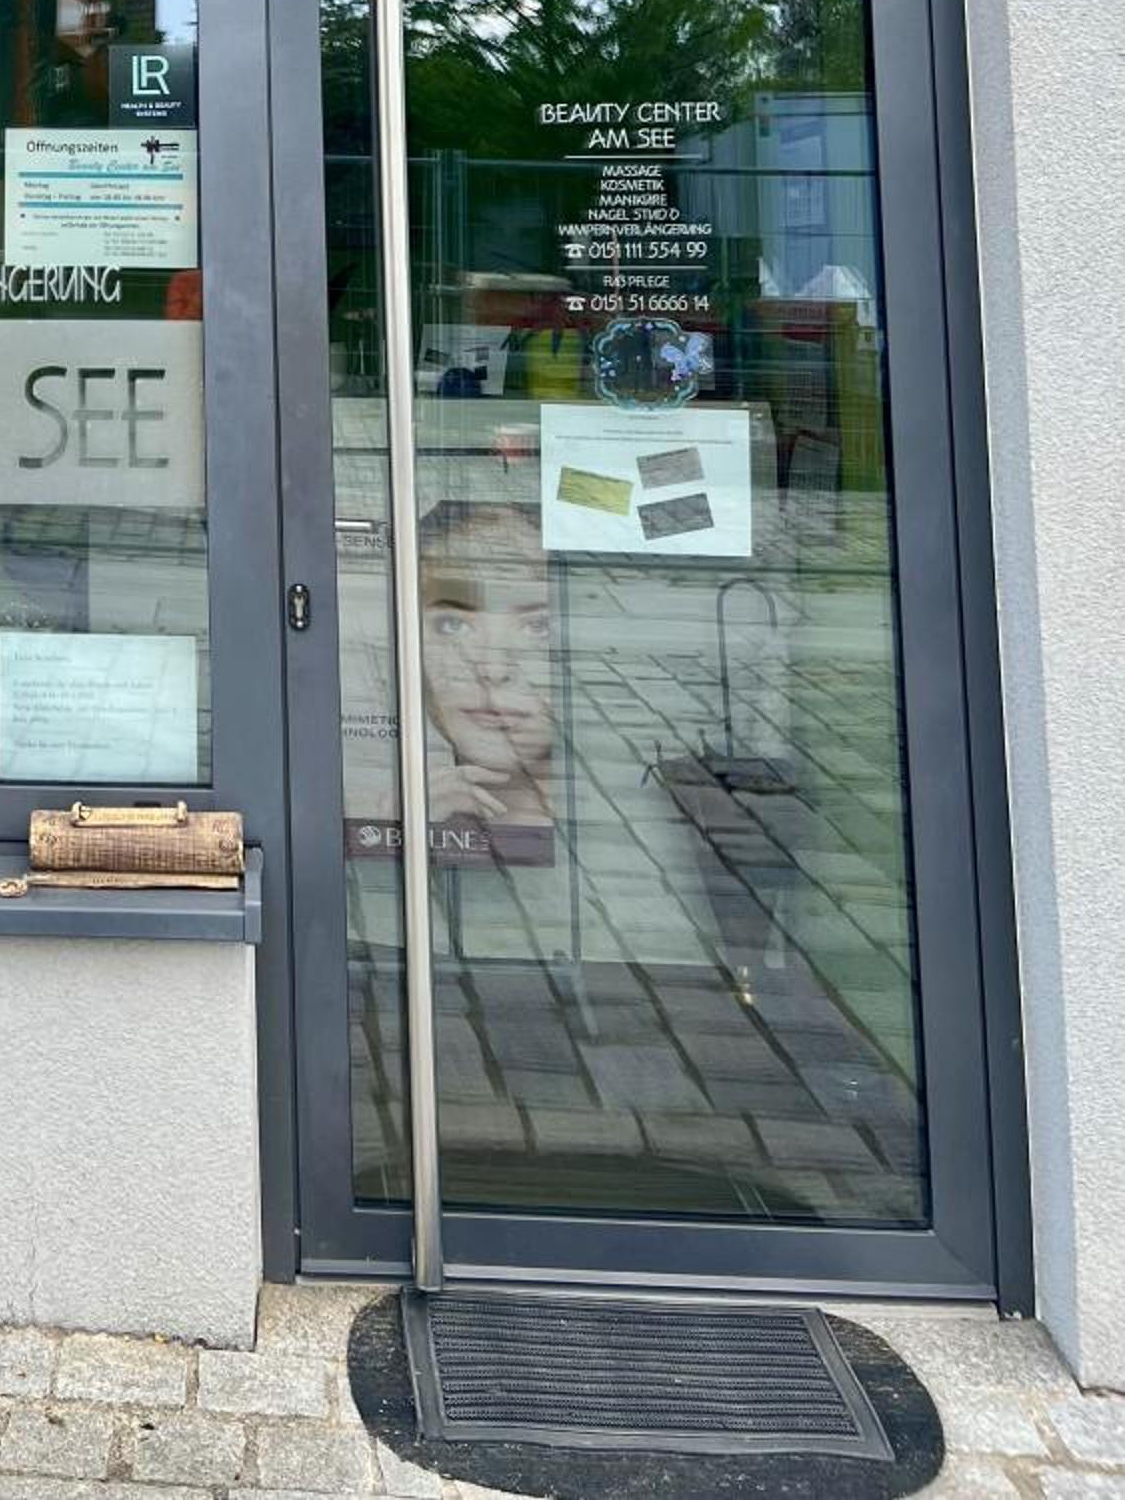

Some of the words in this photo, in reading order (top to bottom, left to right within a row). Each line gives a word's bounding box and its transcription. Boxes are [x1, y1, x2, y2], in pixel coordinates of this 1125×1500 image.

[131, 55, 171, 95] LR
[541, 103, 629, 123] BEAUTY
[637, 102, 722, 122] CENTER
[589, 128, 630, 149] AM
[635, 128, 676, 148] SEE
[603, 165, 662, 177] MASSAGE
[600, 179, 664, 191] KOSMETIK
[588, 209, 629, 220] NAGEL
[589, 242, 620, 258] 0151
[625, 243, 642, 258] 111
[647, 242, 681, 258] 554
[686, 242, 707, 258] 99
[590, 295, 622, 311] 0151
[627, 295, 644, 311] 51
[648, 295, 688, 311] 6666
[694, 296, 709, 311] 14
[18, 365, 170, 469] SEE
[385, 827, 478, 850] BLINE
